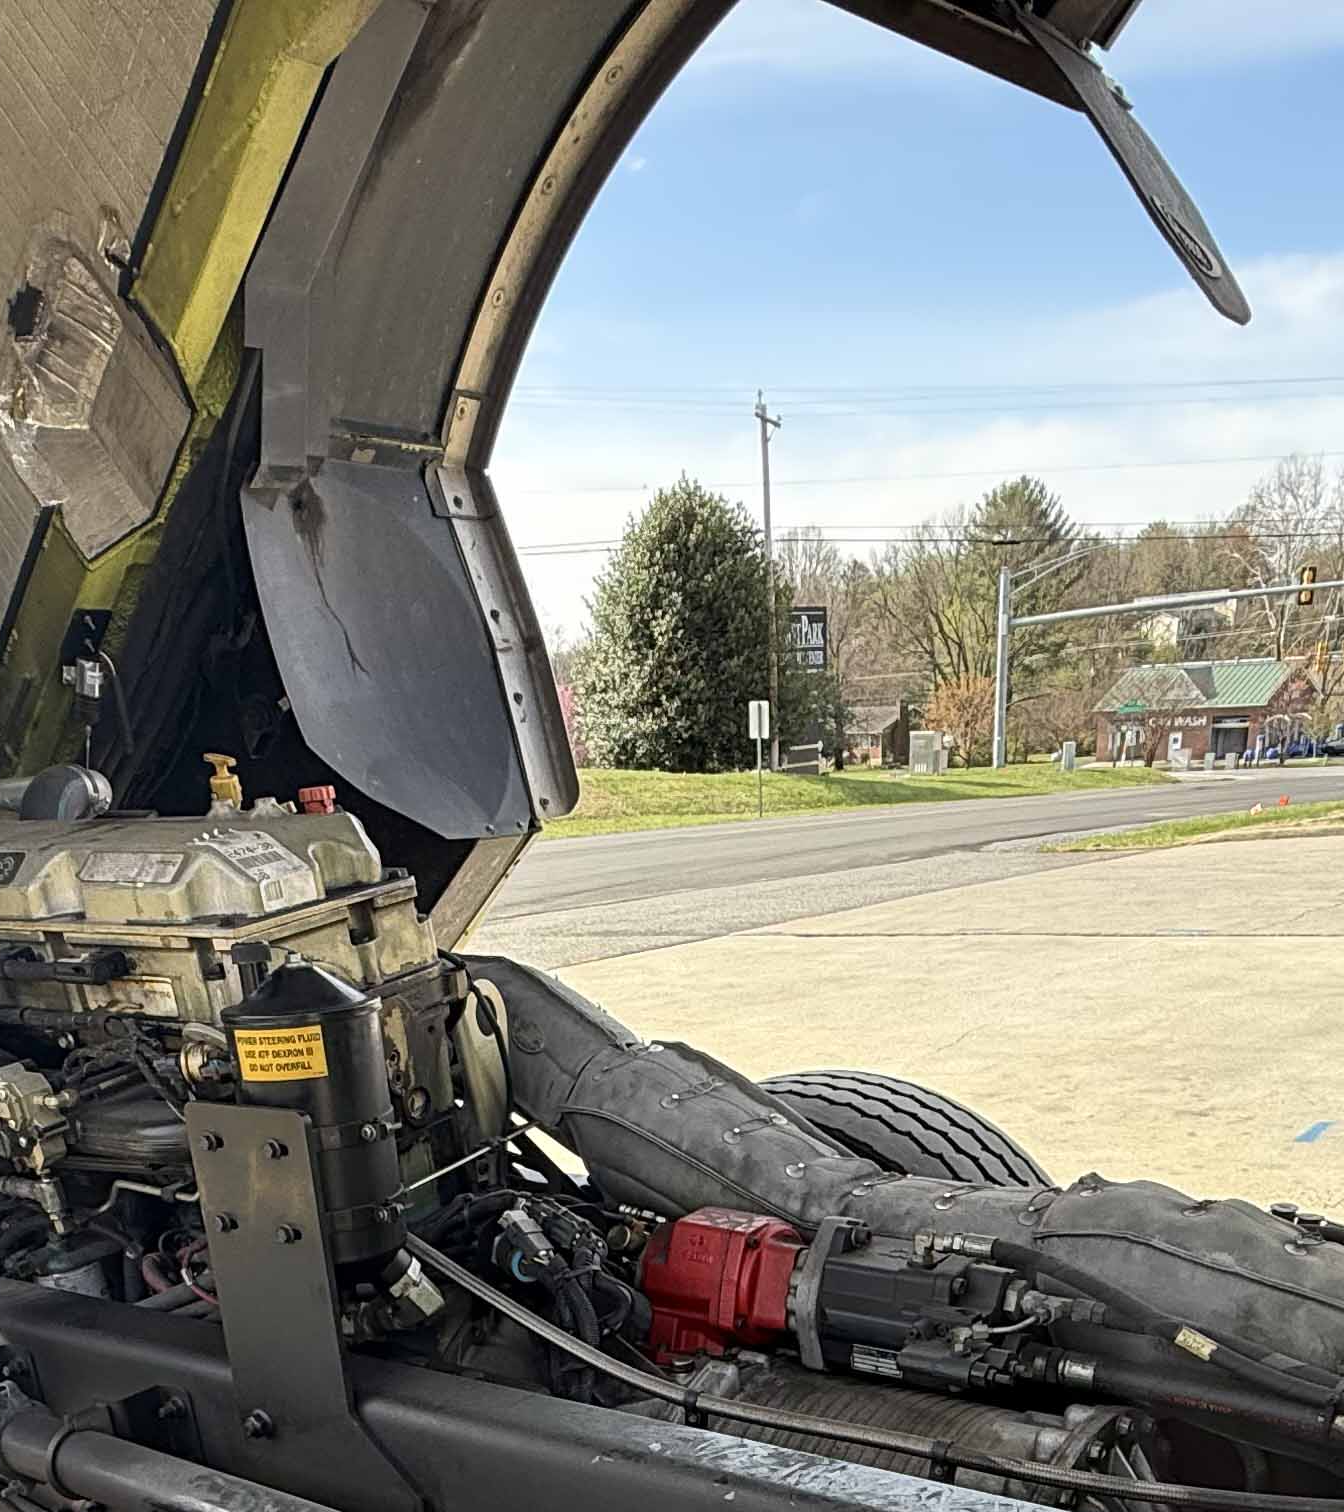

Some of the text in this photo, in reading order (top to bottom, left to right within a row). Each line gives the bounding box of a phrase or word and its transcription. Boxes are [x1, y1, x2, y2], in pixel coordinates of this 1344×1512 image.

[1174, 715, 1207, 727] WASH
[259, 1035, 296, 1045] STEERING
[297, 1032, 321, 1044] FLUID
[244, 1050, 256, 1059] USE
[258, 1049, 269, 1058] ATF
[272, 1047, 304, 1058] DEXRON
[249, 1060, 312, 1072] DO NOT OVERFILL
